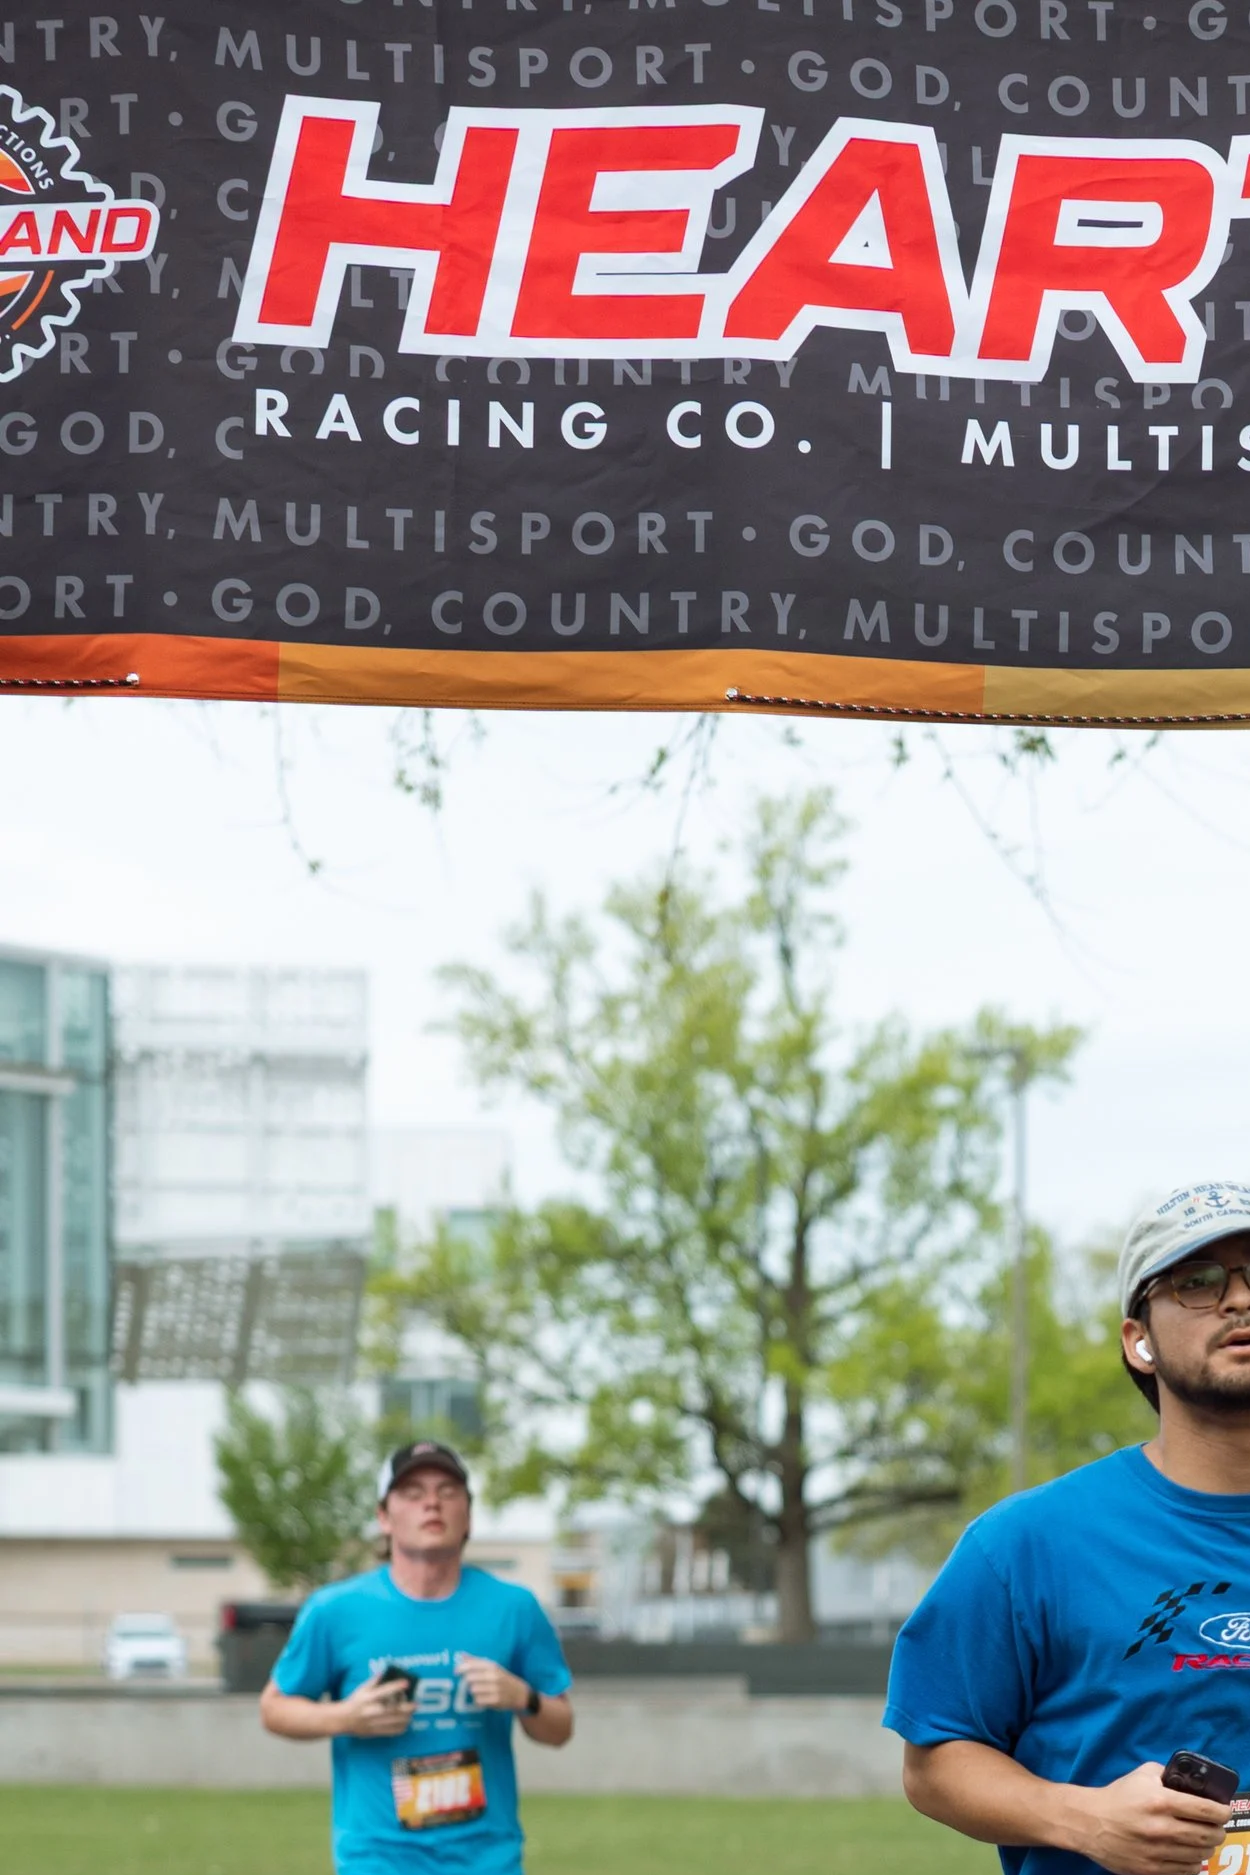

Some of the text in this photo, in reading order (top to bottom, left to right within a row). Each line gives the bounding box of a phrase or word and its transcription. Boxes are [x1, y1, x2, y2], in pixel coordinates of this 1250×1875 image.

[215, 27, 711, 89] MULTISPORT
[787, 50, 961, 112] GOD,
[0, 411, 176, 459] GOD,
[255, 386, 609, 449] RACING
[665, 400, 813, 455] CO.
[212, 498, 713, 555] MULTISPORT
[788, 513, 965, 571] GOD,
[212, 578, 391, 634] GOD,
[431, 590, 806, 639] COUNTRY,
